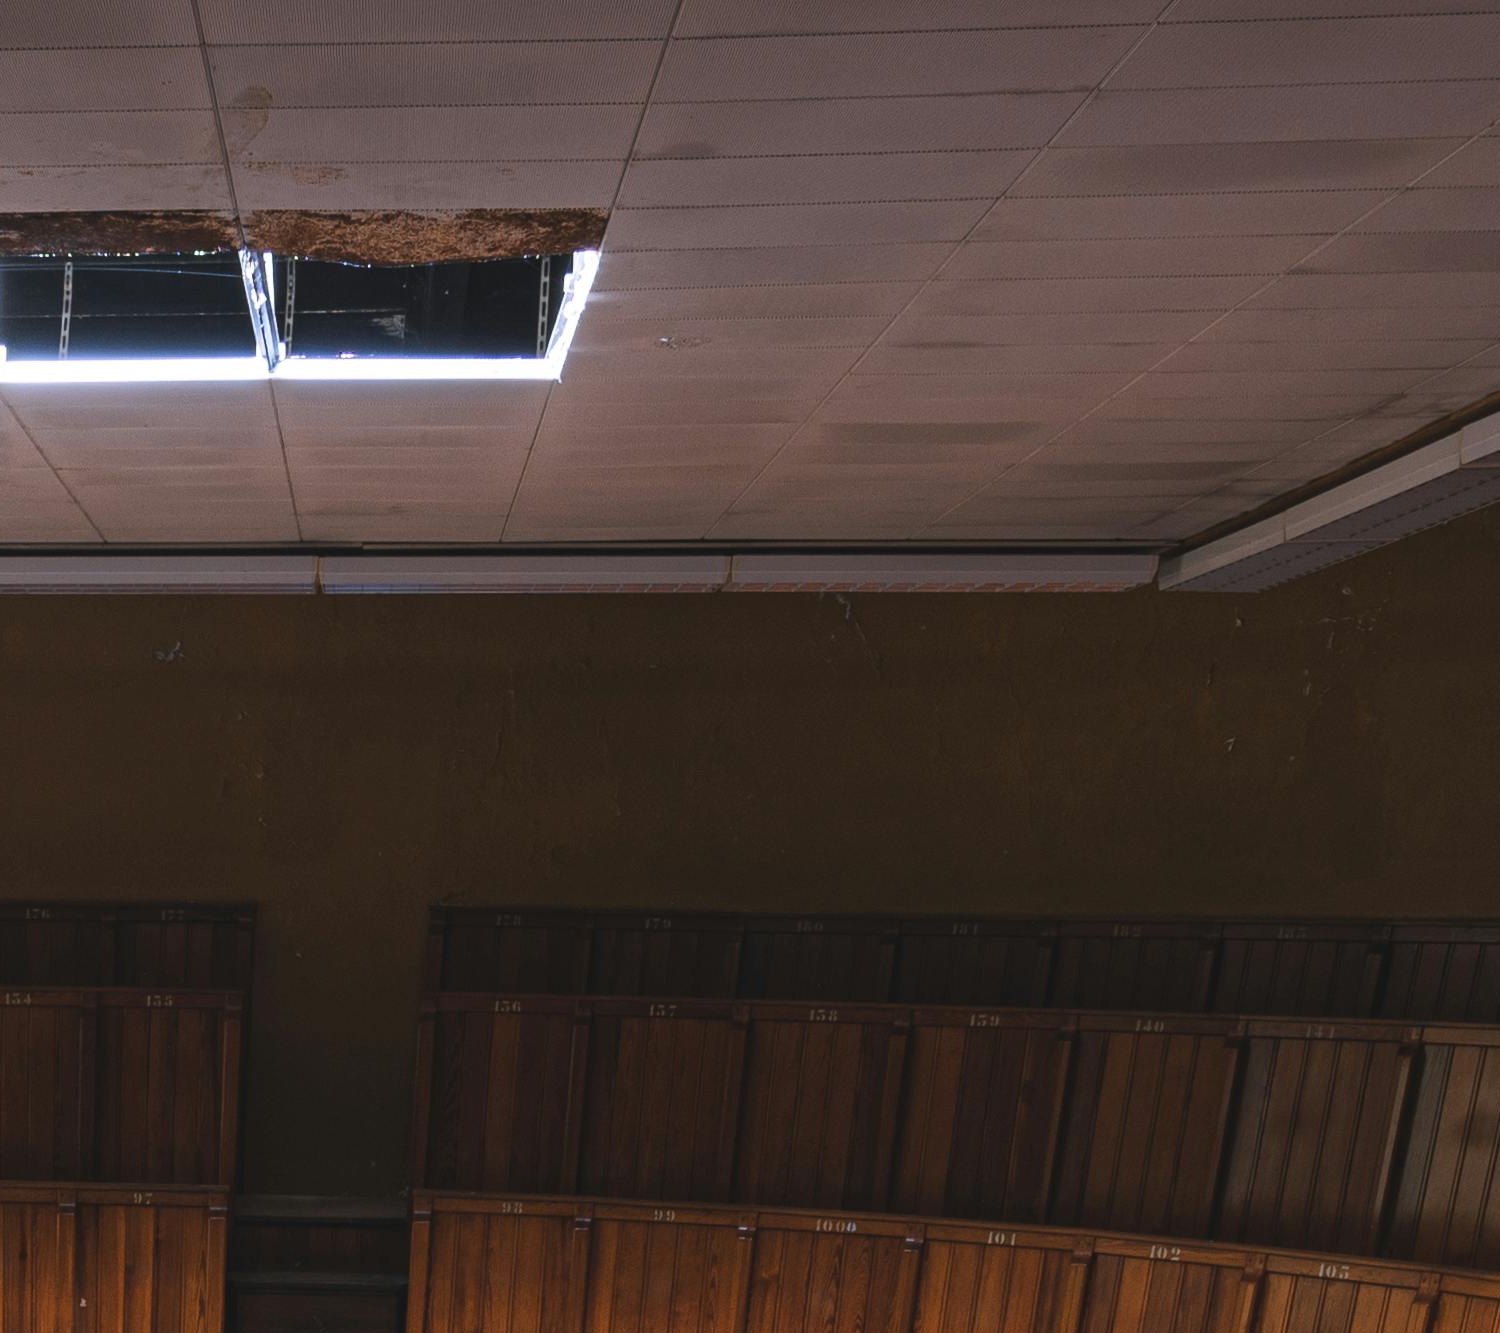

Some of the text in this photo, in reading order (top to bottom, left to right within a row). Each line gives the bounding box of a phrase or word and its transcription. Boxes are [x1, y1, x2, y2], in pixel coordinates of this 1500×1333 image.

[26, 909, 50, 919] 176
[645, 918, 671, 929] 179
[952, 924, 978, 934] 181
[1114, 926, 1141, 937] 182
[6, 993, 31, 1004] 134
[147, 995, 173, 1007] 135
[495, 1001, 521, 1011] 136
[650, 1004, 677, 1016] 137
[810, 1009, 837, 1021] 138
[970, 1014, 1000, 1026] 139
[1136, 1020, 1164, 1032] 140
[134, 1193, 153, 1204] 97
[502, 1202, 523, 1214] 98
[654, 1210, 675, 1221] 99
[988, 1232, 1016, 1245] 101
[1150, 1246, 1181, 1260] 102
[1319, 1263, 1349, 1278] 103
